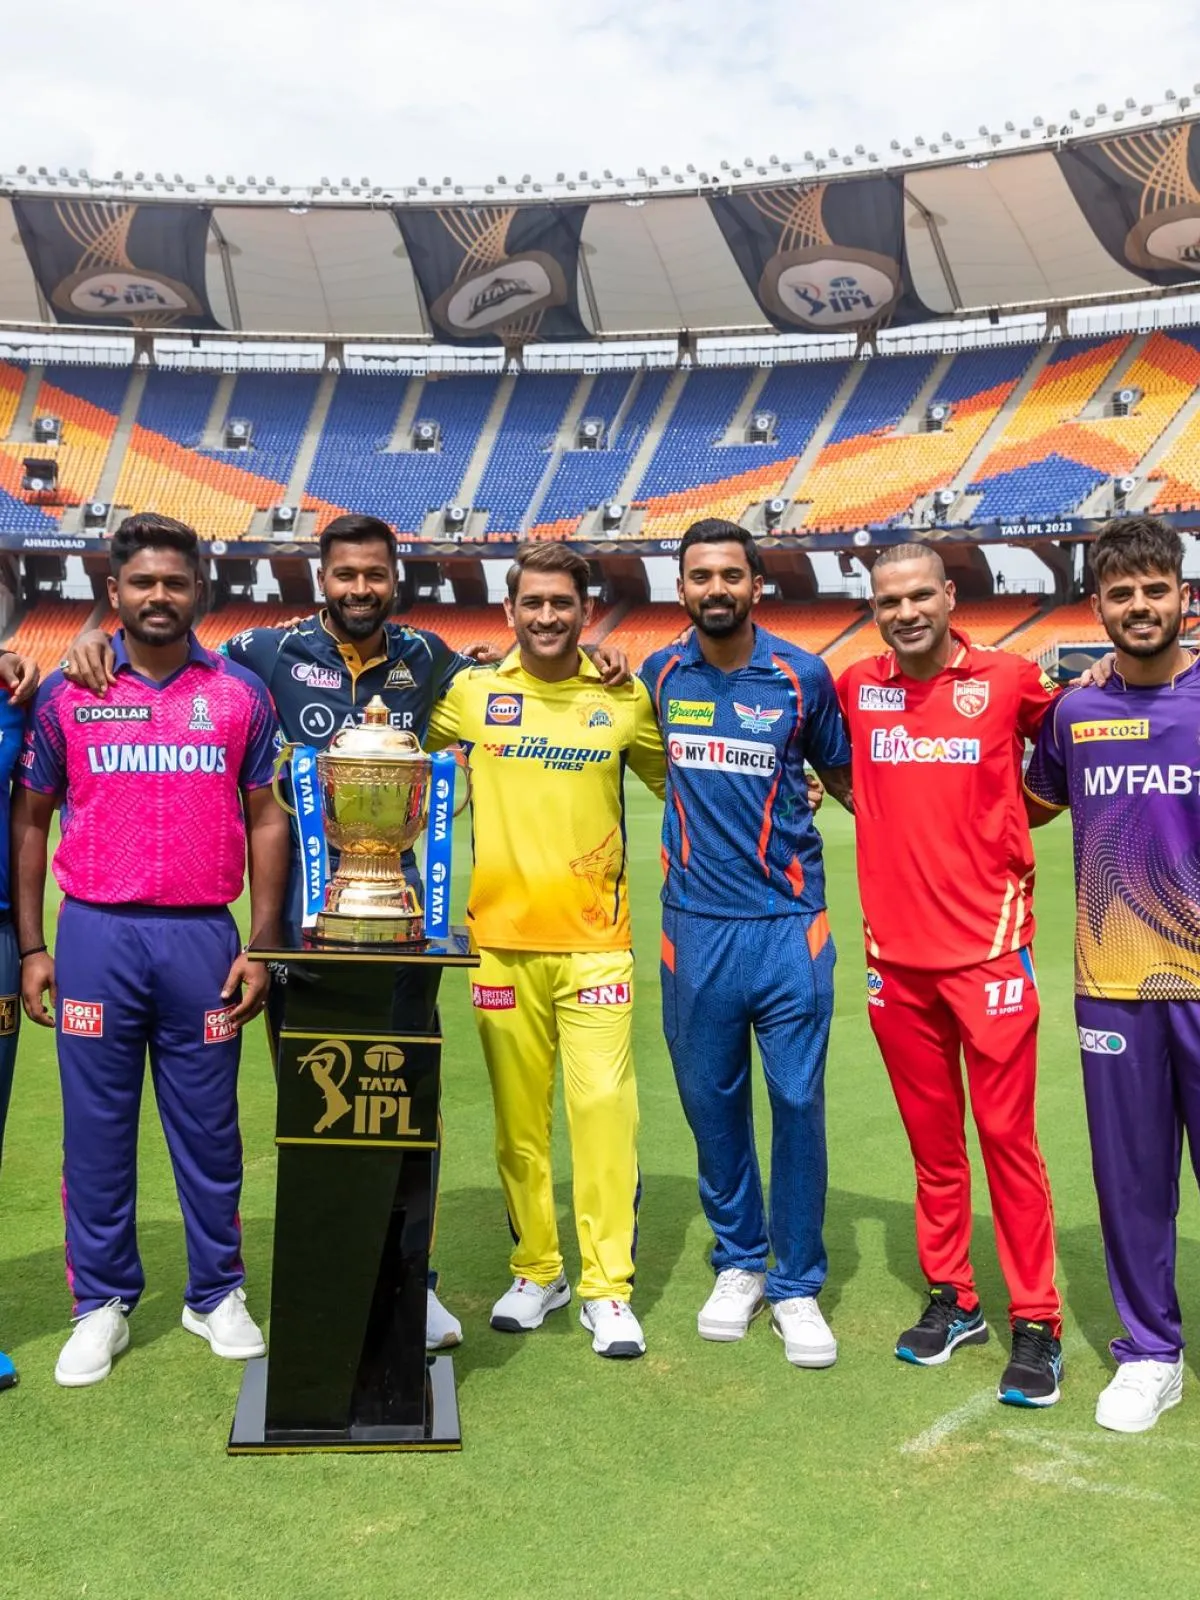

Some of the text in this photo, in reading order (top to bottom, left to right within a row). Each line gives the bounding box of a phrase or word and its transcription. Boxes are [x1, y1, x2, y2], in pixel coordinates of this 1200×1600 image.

[829, 294, 876, 313] IPL
[1001, 522, 1072, 535] TATA IPL 2023
[23, 539, 86, 549] AHMEDABAD
[293, 662, 340, 681] CAPRI
[309, 679, 340, 687] LOANS
[860, 687, 904, 703] LOTUS
[91, 708, 149, 719] DOLLAR
[489, 705, 519, 714] Gulf
[669, 702, 714, 722] Greenply
[341, 711, 414, 729] ATER
[521, 736, 548, 745] TVS
[87, 744, 227, 773] LUMINOUS
[503, 745, 611, 763] EUROGRIP
[544, 761, 585, 771] TYRES
[300, 775, 315, 816] TATA
[434, 801, 448, 841] TATA
[310, 859, 321, 900] TATA
[432, 886, 444, 926] TATA
[482, 990, 513, 998] BRITISH
[482, 998, 514, 1006] EMPIRE
[579, 985, 629, 1003] SNJ
[65, 1004, 99, 1018] GOEL
[68, 1018, 96, 1031] TMT
[358, 1077, 407, 1092] TATA
[353, 1096, 420, 1135] IPL
